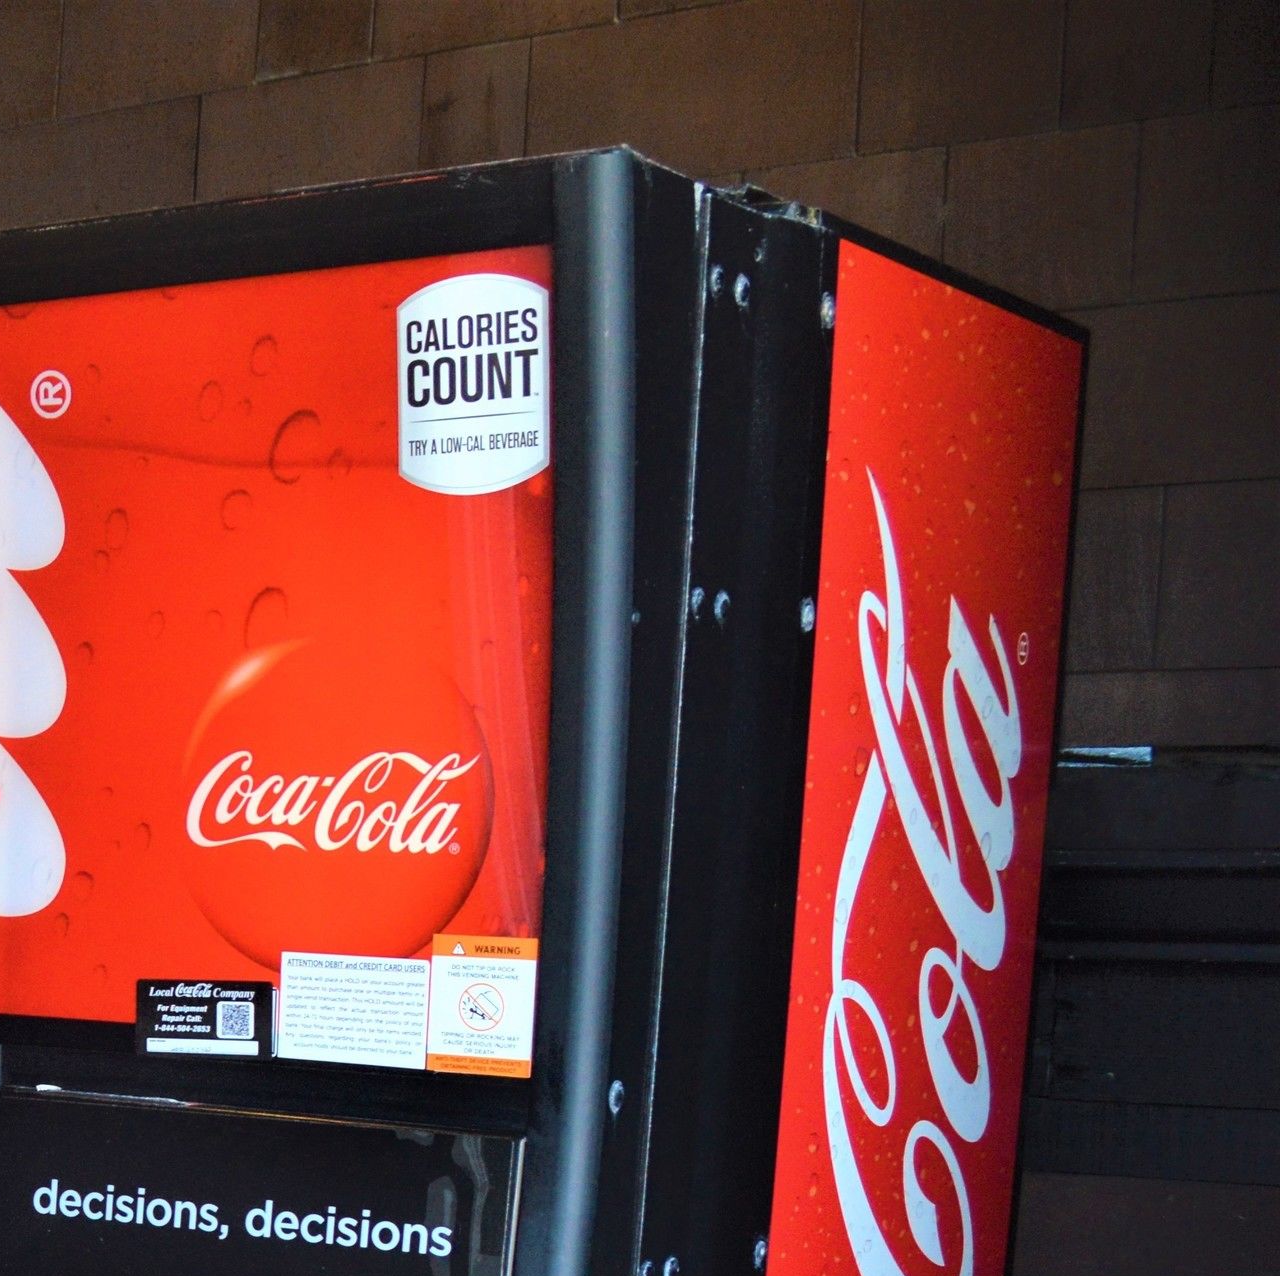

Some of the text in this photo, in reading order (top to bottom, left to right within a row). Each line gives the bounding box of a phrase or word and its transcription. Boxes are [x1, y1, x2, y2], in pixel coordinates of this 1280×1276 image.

[405, 307, 538, 355] CALORIES
[407, 349, 539, 408] COUNT
[408, 429, 539, 457] TRY A LOW-CAL BEVERAGE
[186, 750, 480, 855] Coca-Cola
[475, 945, 521, 956] WARNING
[287, 958, 425, 974] ATTENTION DEBIT and CREDIT CARD USERS
[149, 986, 174, 997] Local
[213, 987, 256, 1000] Company
[157, 1004, 208, 1013] For Equipment
[161, 1014, 185, 1023] Repair
[32, 1179, 453, 1257] decisions, decisions
